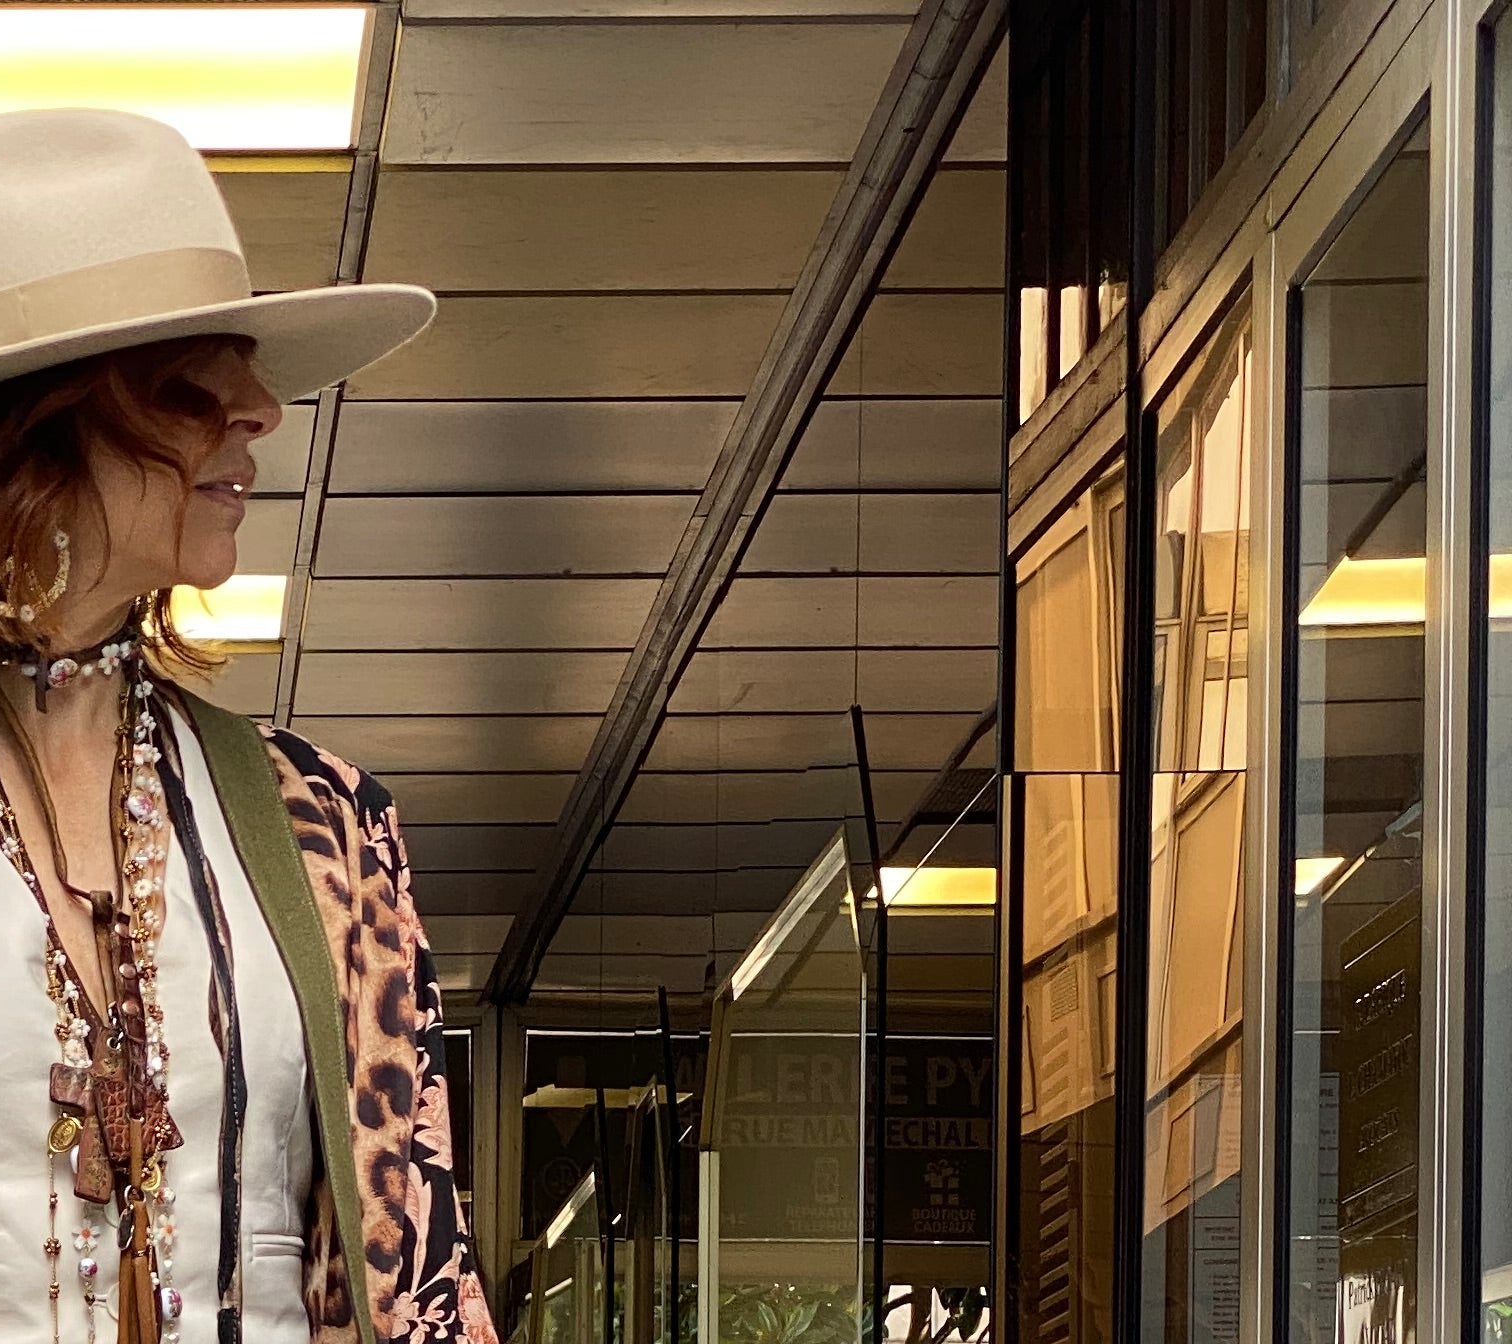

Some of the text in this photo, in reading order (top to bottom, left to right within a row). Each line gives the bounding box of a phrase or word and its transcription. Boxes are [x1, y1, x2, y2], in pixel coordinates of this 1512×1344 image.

[721, 1117, 979, 1147] RUE MAECHAL
[911, 1207, 977, 1221] BOUTIQUE
[913, 1220, 975, 1233] CADEAUX
